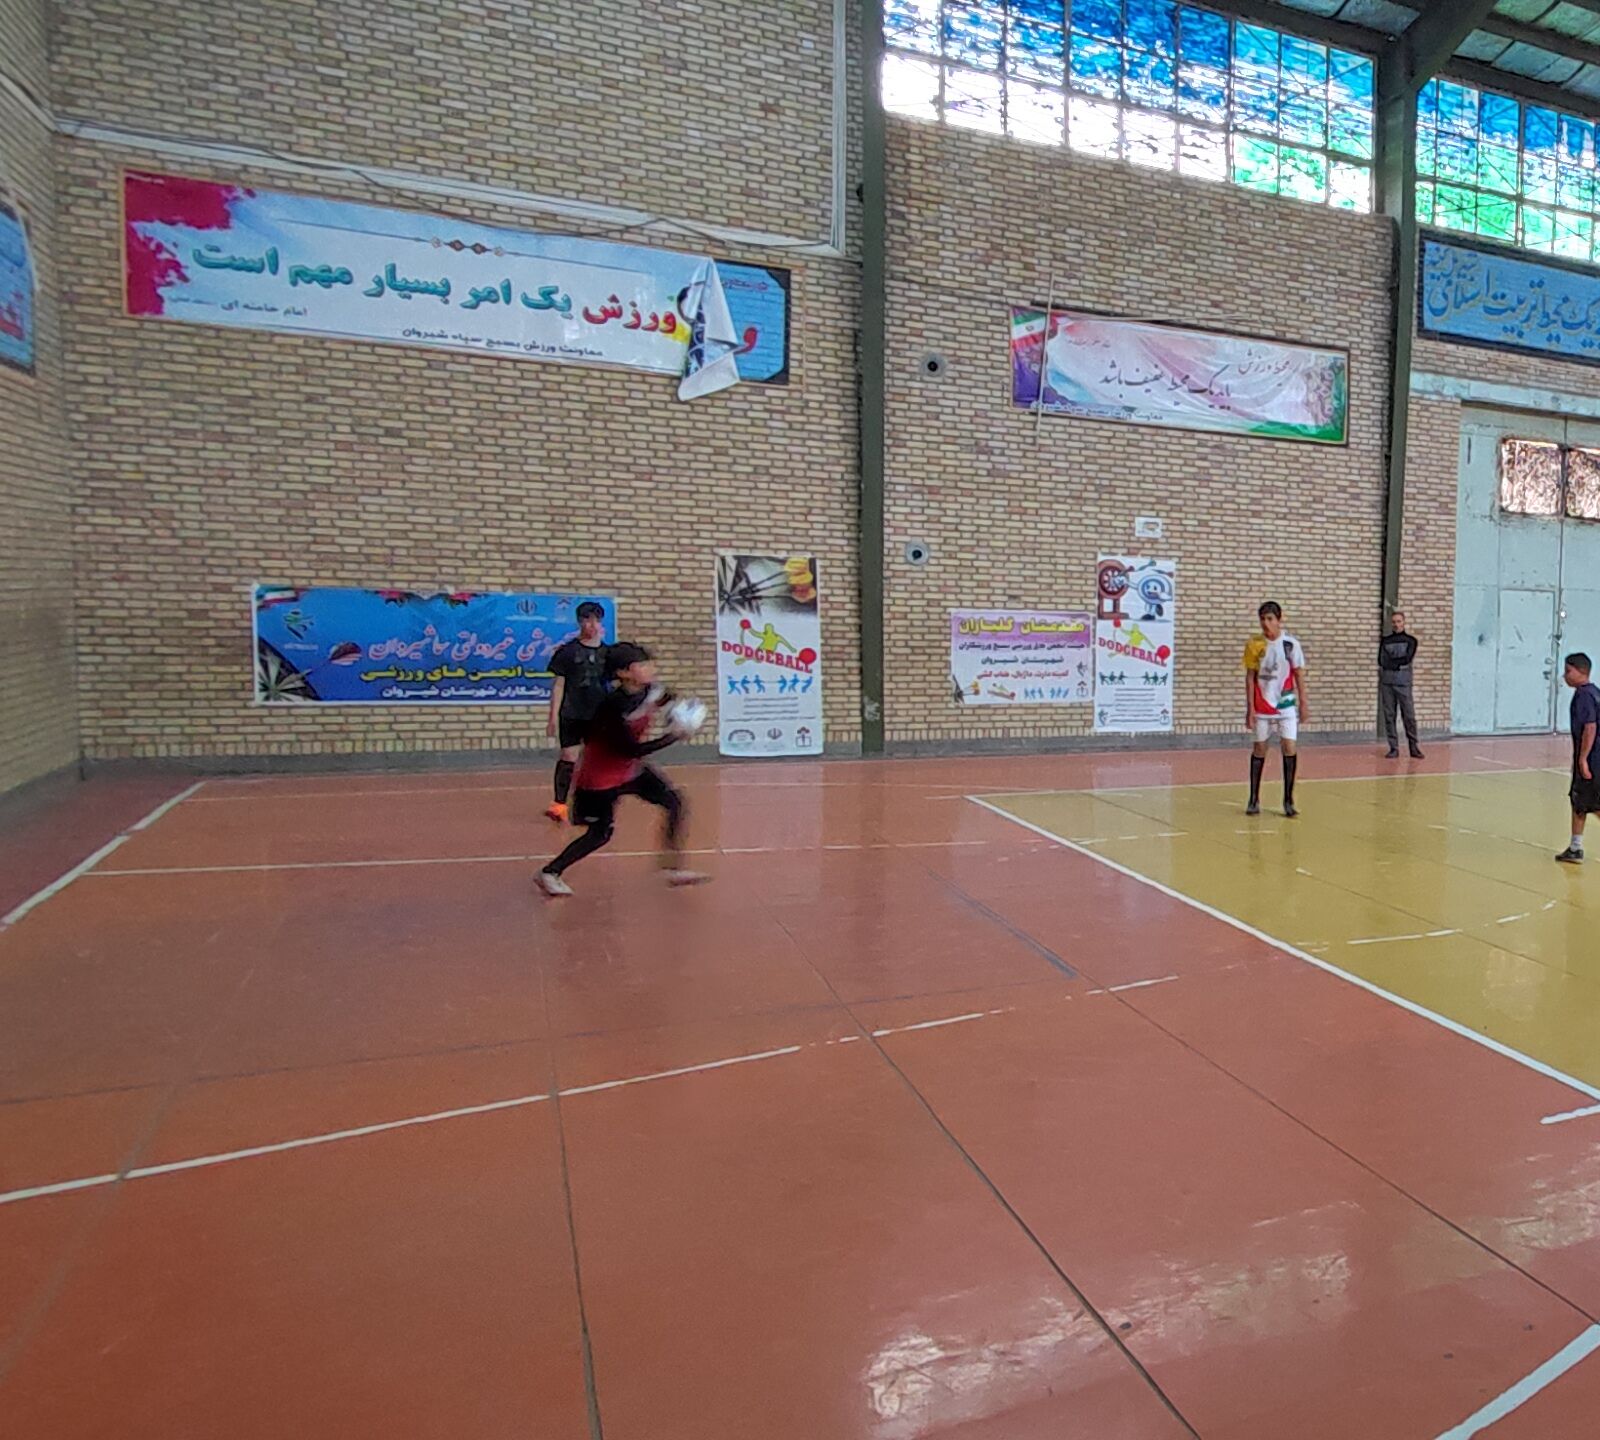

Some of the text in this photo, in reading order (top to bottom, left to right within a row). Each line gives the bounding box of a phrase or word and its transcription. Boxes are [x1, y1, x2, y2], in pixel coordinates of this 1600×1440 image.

[192, 244, 677, 334] ورزش یک امر بسیار مهم است
[402, 327, 448, 340] شیروان
[524, 340, 556, 354] ورزش
[721, 641, 813, 673] DODGEBALL
[1098, 637, 1168, 667] DODGEBALL
[361, 664, 425, 681] ورزشی
[426, 664, 466, 681] های
[382, 684, 552, 698] رزشکاران شهرستان شیروان
